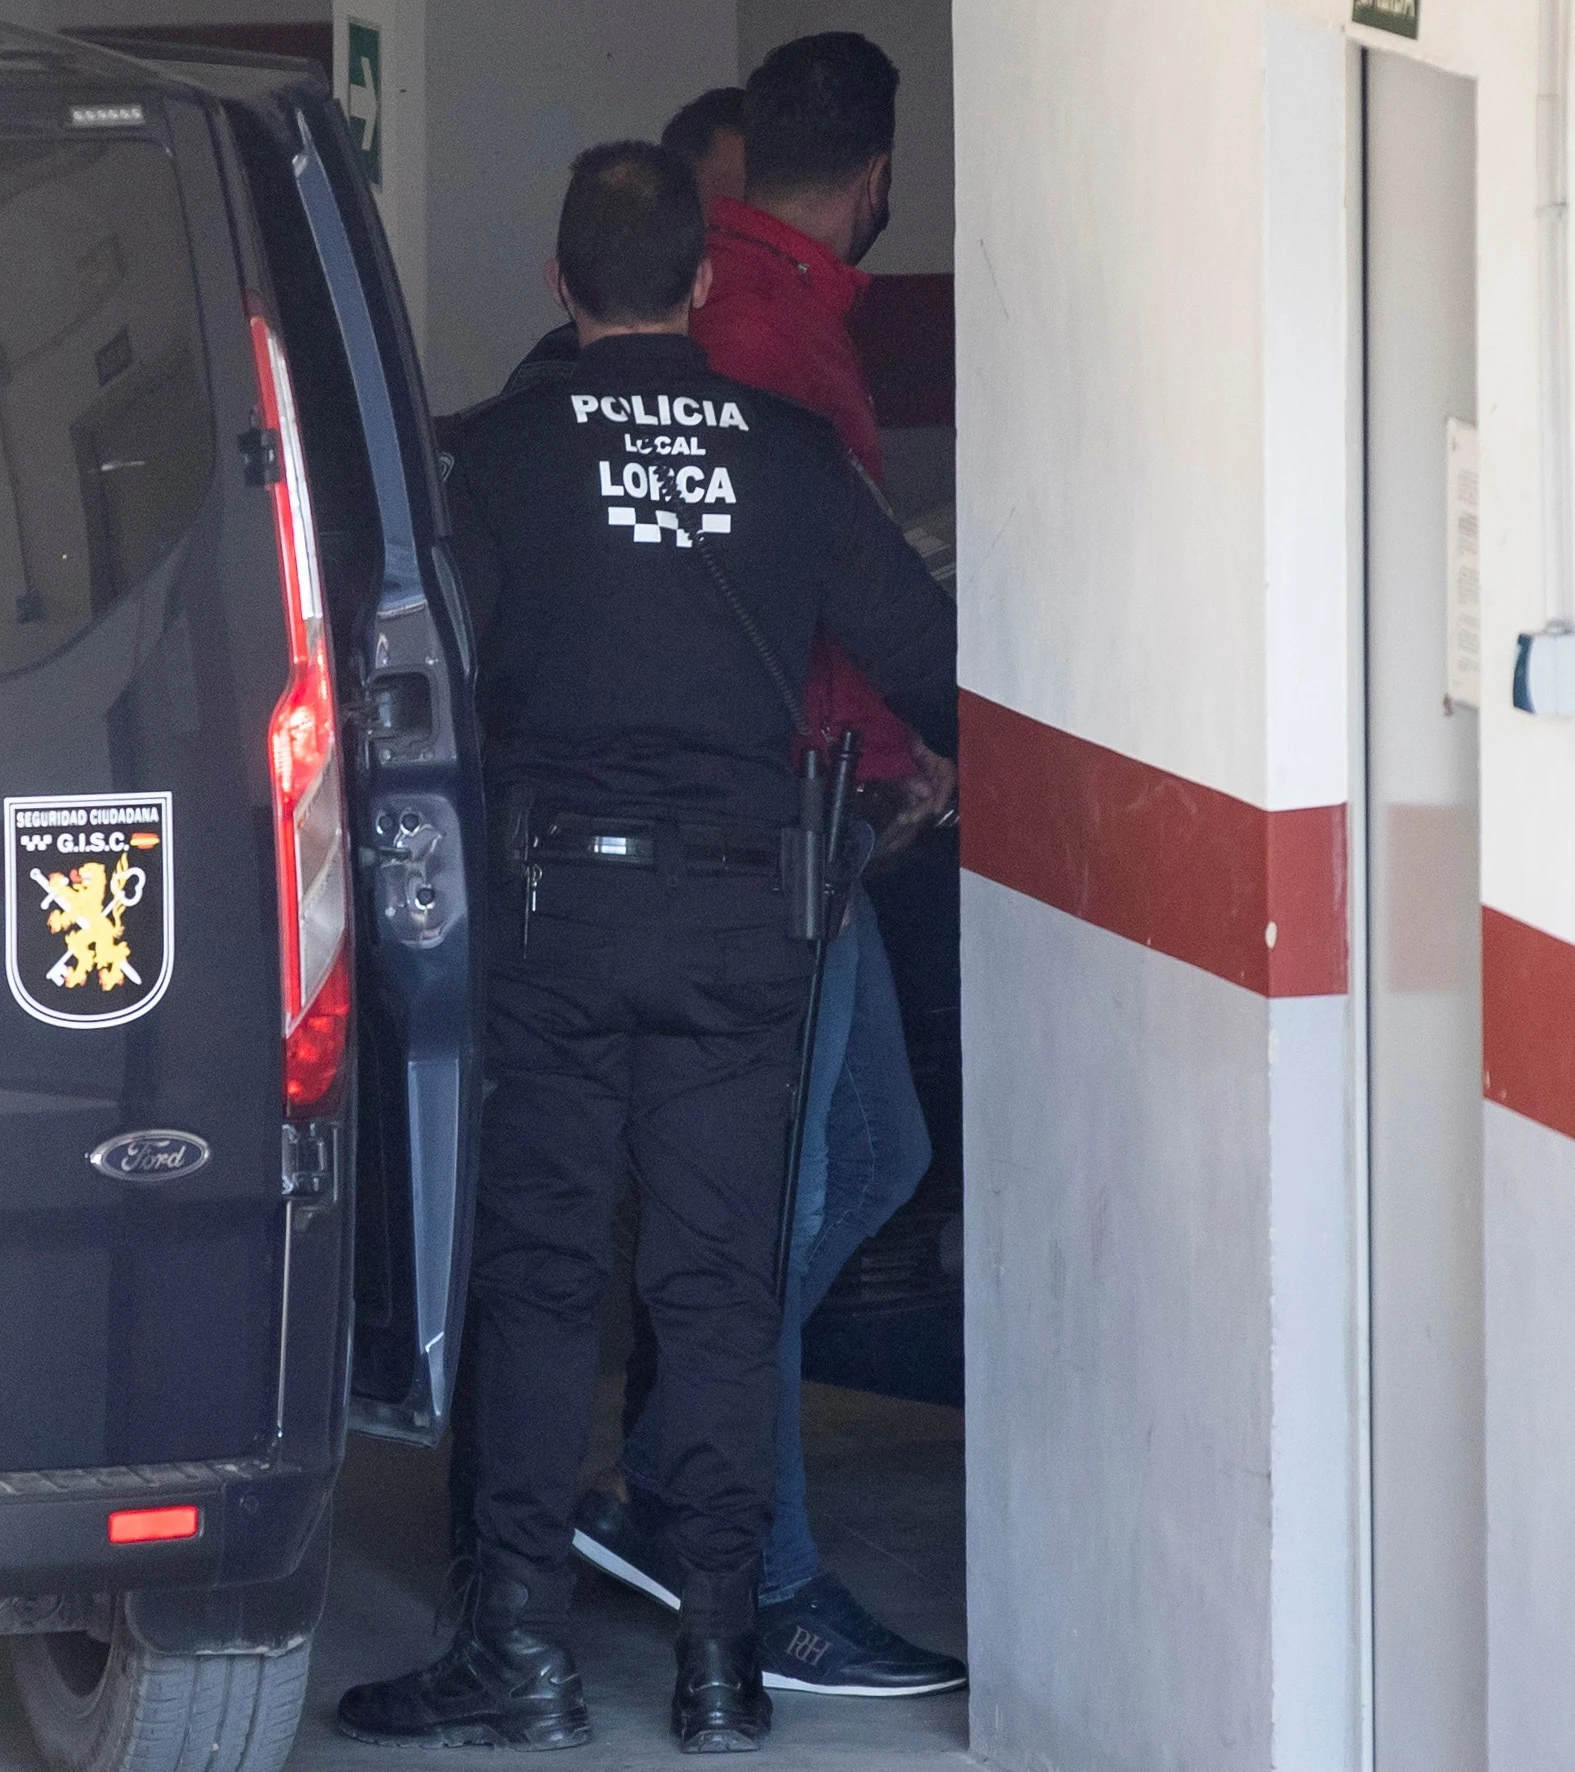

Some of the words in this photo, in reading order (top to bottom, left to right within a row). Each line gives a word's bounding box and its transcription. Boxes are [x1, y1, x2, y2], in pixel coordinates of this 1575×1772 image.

[571, 395, 749, 431] POLICIA
[16, 809, 88, 828] SEGURIDAD
[89, 807, 159, 825] CIUDADANA
[56, 832, 130, 853] G.I.S.C.
[121, 1140, 187, 1172] Ford
